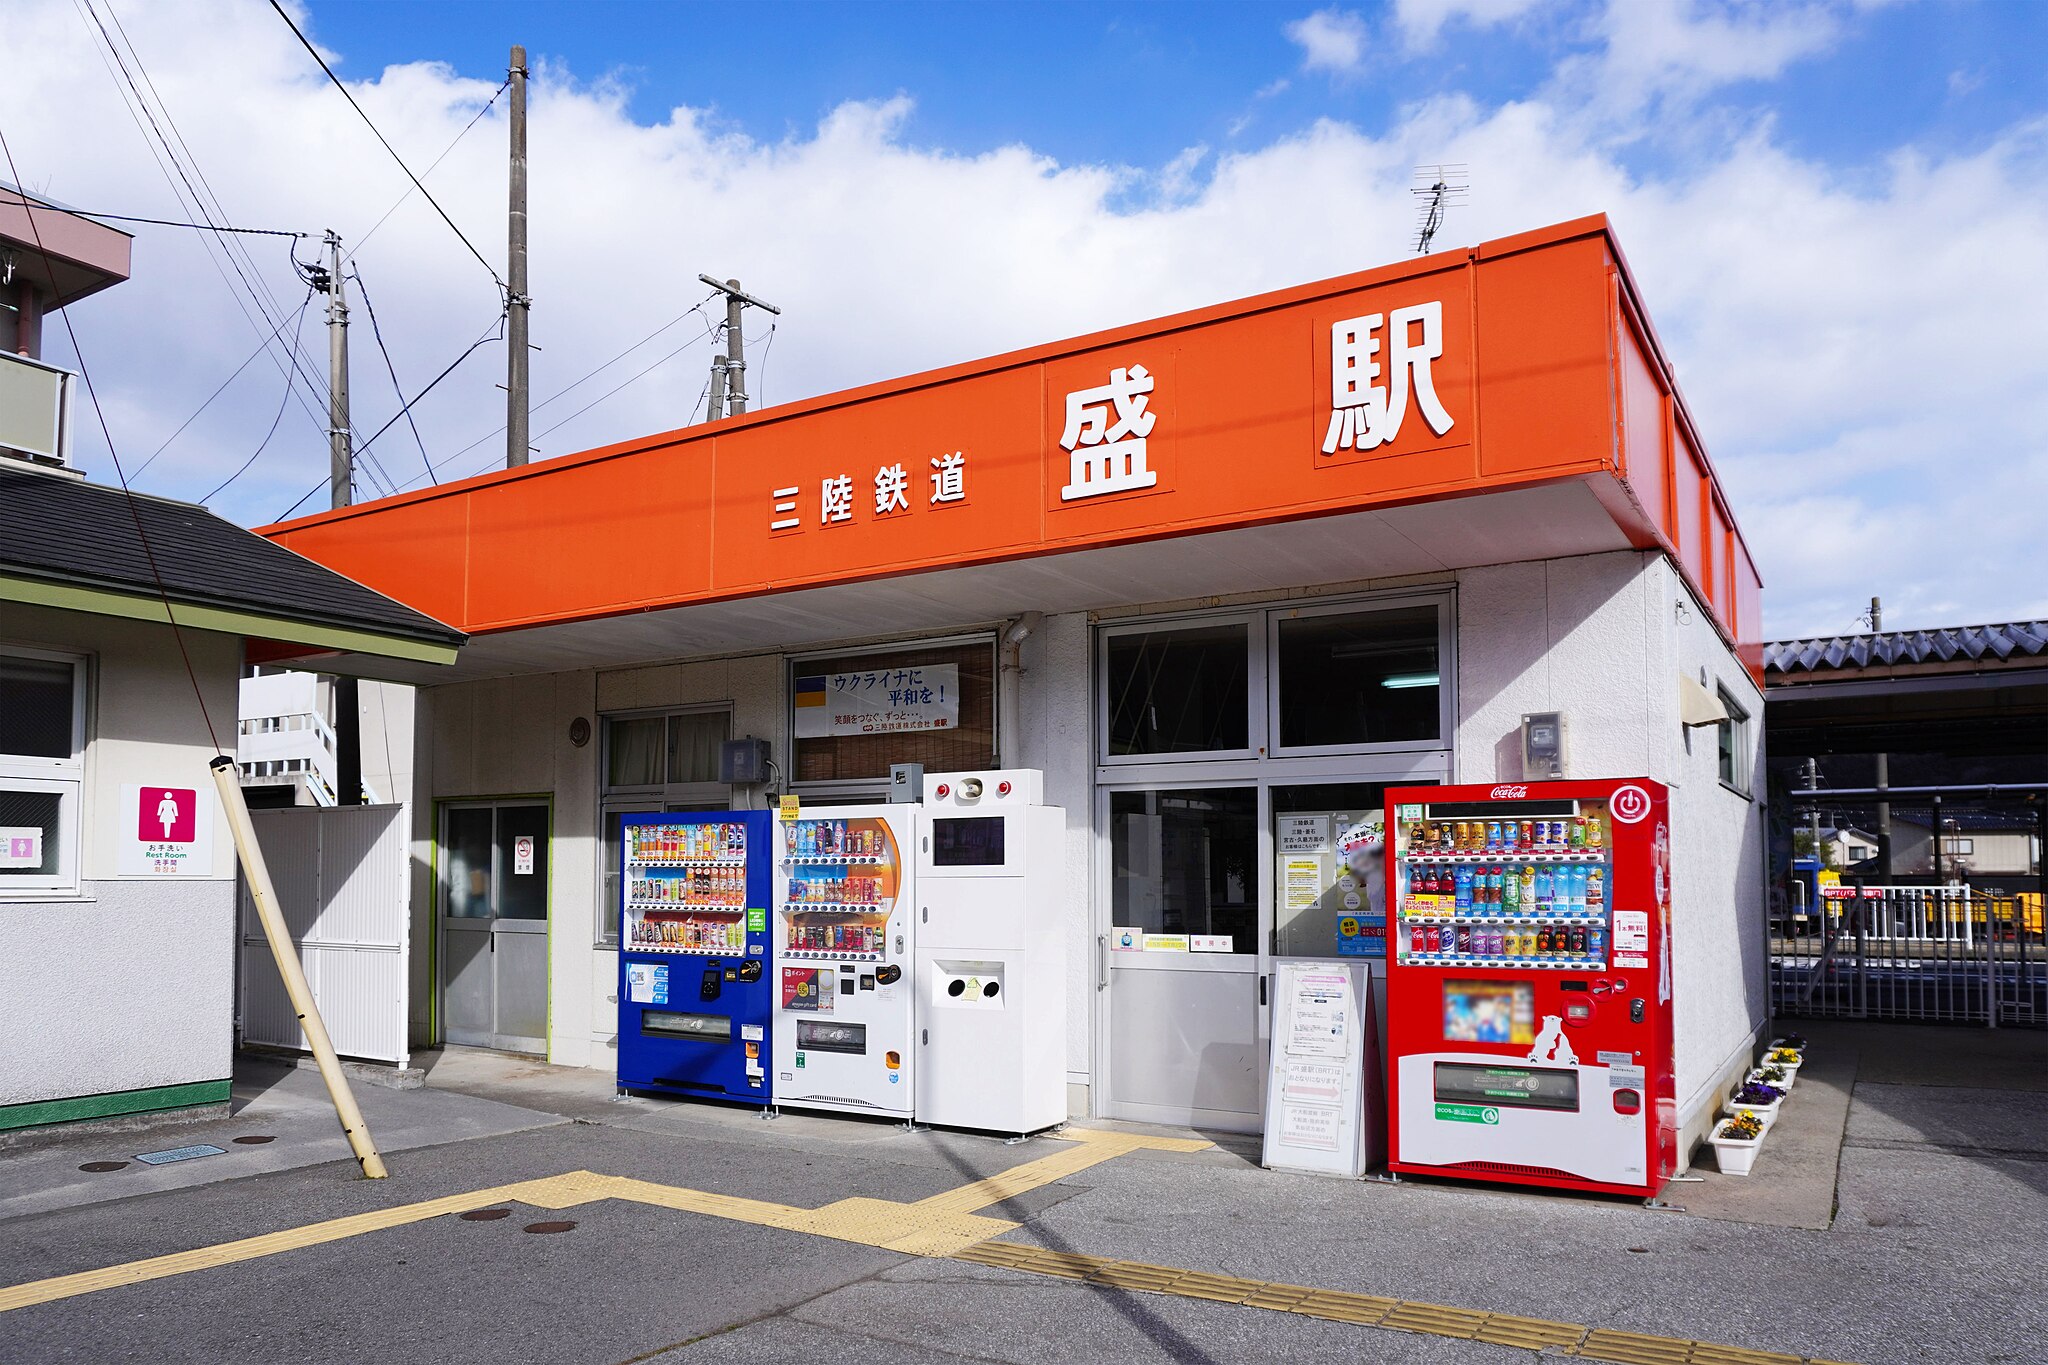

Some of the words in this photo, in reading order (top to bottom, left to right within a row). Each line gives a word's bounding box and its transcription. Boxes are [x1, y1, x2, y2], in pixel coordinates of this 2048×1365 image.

[770, 451, 966, 530] 三陸鉄道
[834, 670, 923, 692] ウクライナに
[888, 685, 945, 707] 平和を！
[875, 721, 930, 731] 三陸鉄道株式会社
[934, 719, 948, 727] 盛駅
[1490, 785, 1529, 799] Coca-Cola
[1616, 920, 1646, 932] 1本無料!
